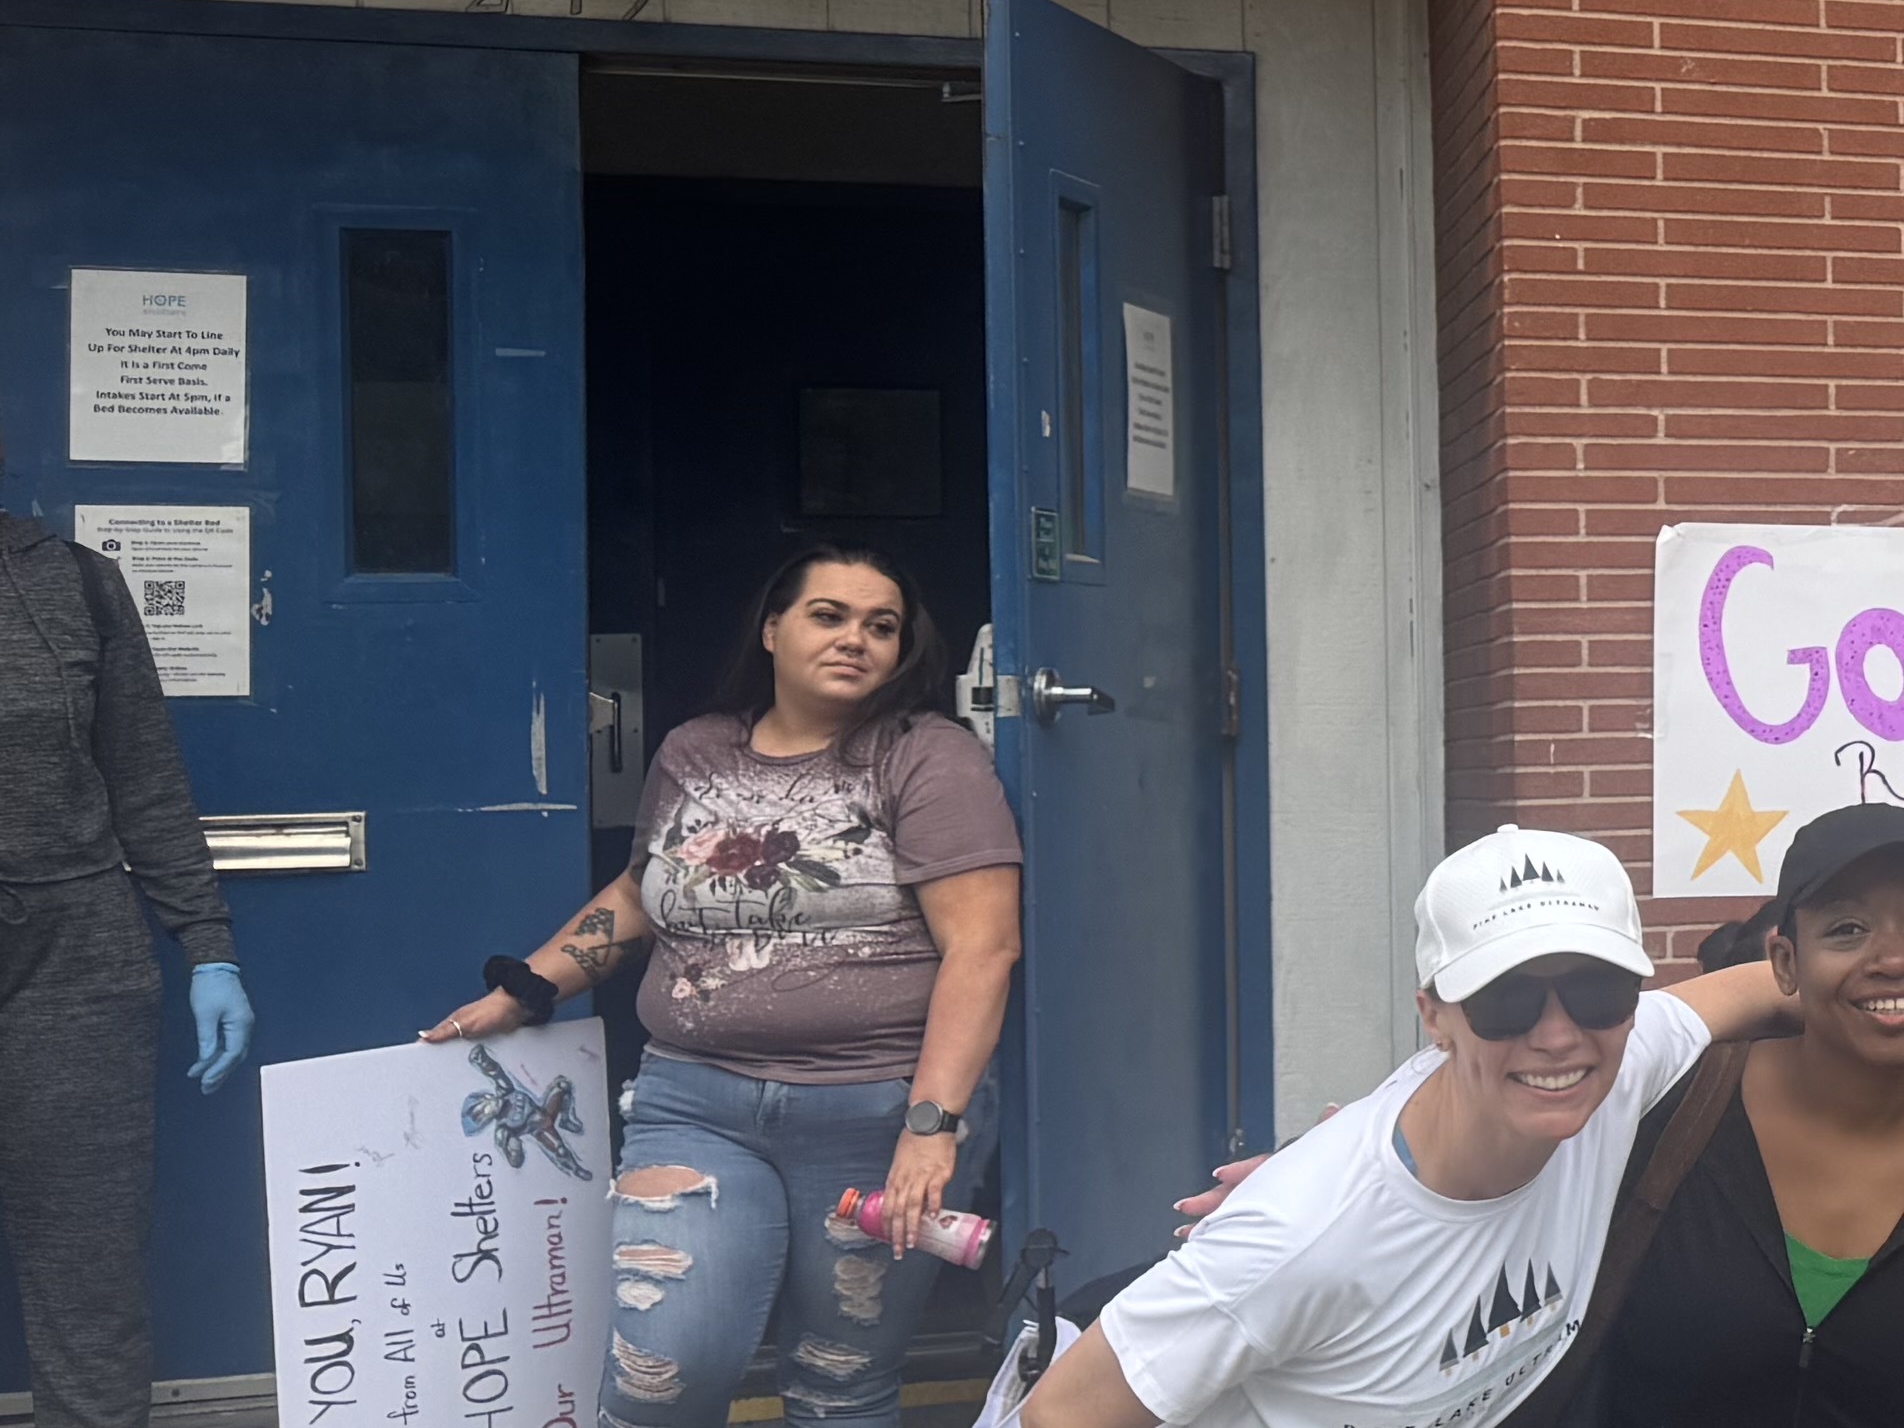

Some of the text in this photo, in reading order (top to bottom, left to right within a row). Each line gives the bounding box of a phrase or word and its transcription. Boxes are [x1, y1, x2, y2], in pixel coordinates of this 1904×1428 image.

[142, 294, 187, 308] HOPE
[105, 327, 224, 341] You May Start To Line
[88, 343, 241, 358] Up For Shelter At 4pm Daily
[142, 362, 149, 370] a
[152, 360, 175, 370] First
[177, 361, 208, 371] Come
[120, 375, 143, 385] First
[145, 375, 176, 386] Serve
[96, 390, 136, 400] Intakes
[138, 391, 166, 401] Start
[168, 392, 180, 402] At
[93, 404, 115, 414] Bed
[117, 404, 168, 415] Becomes
[450, 1151, 503, 1285] Shelters
[298, 1160, 362, 1308] RYAN!
[532, 1196, 576, 1351] Ultraman!
[432, 1321, 447, 1339] at
[383, 1262, 420, 1427] from All of Us
[1434, 1387, 1493, 1428] LAKE
